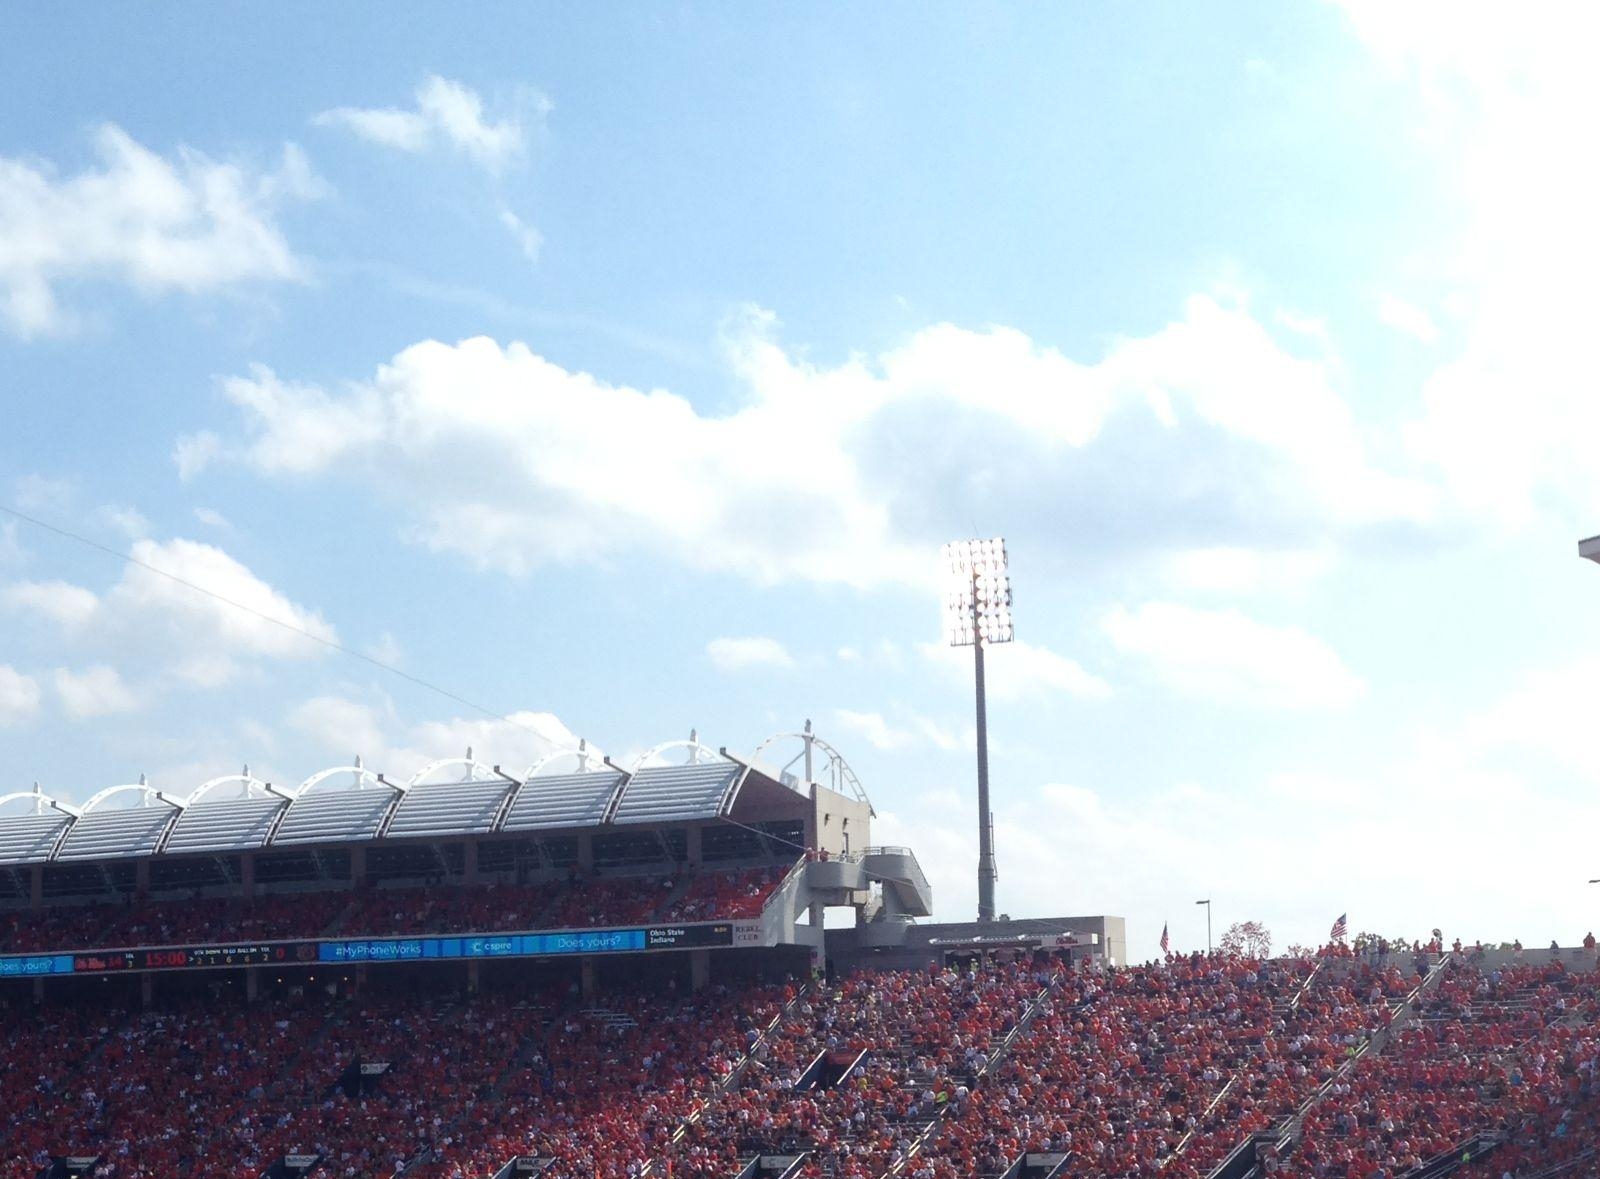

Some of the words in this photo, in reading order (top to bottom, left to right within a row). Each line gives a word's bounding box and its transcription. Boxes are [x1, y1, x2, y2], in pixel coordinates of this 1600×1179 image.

[558, 937, 584, 948] Does
[586, 935, 621, 949] yours?
[336, 944, 421, 957] #MyPhoneWorks
